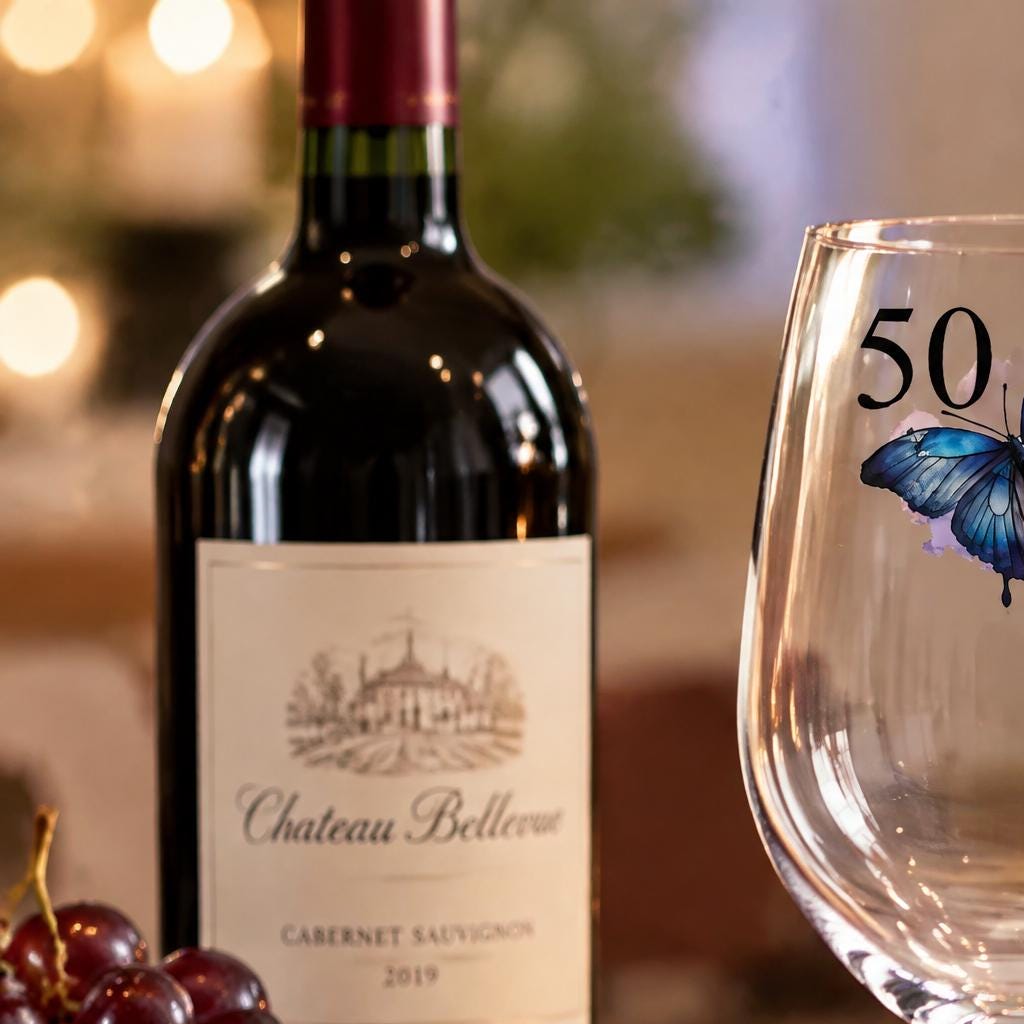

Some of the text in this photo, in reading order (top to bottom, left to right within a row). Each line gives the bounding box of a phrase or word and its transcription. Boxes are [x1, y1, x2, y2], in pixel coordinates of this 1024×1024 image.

[857, 306, 993, 410] 50
[235, 782, 397, 846] Chateau
[281, 921, 535, 947] CABERNET SAUVIGNON
[383, 965, 439, 988] 2019
